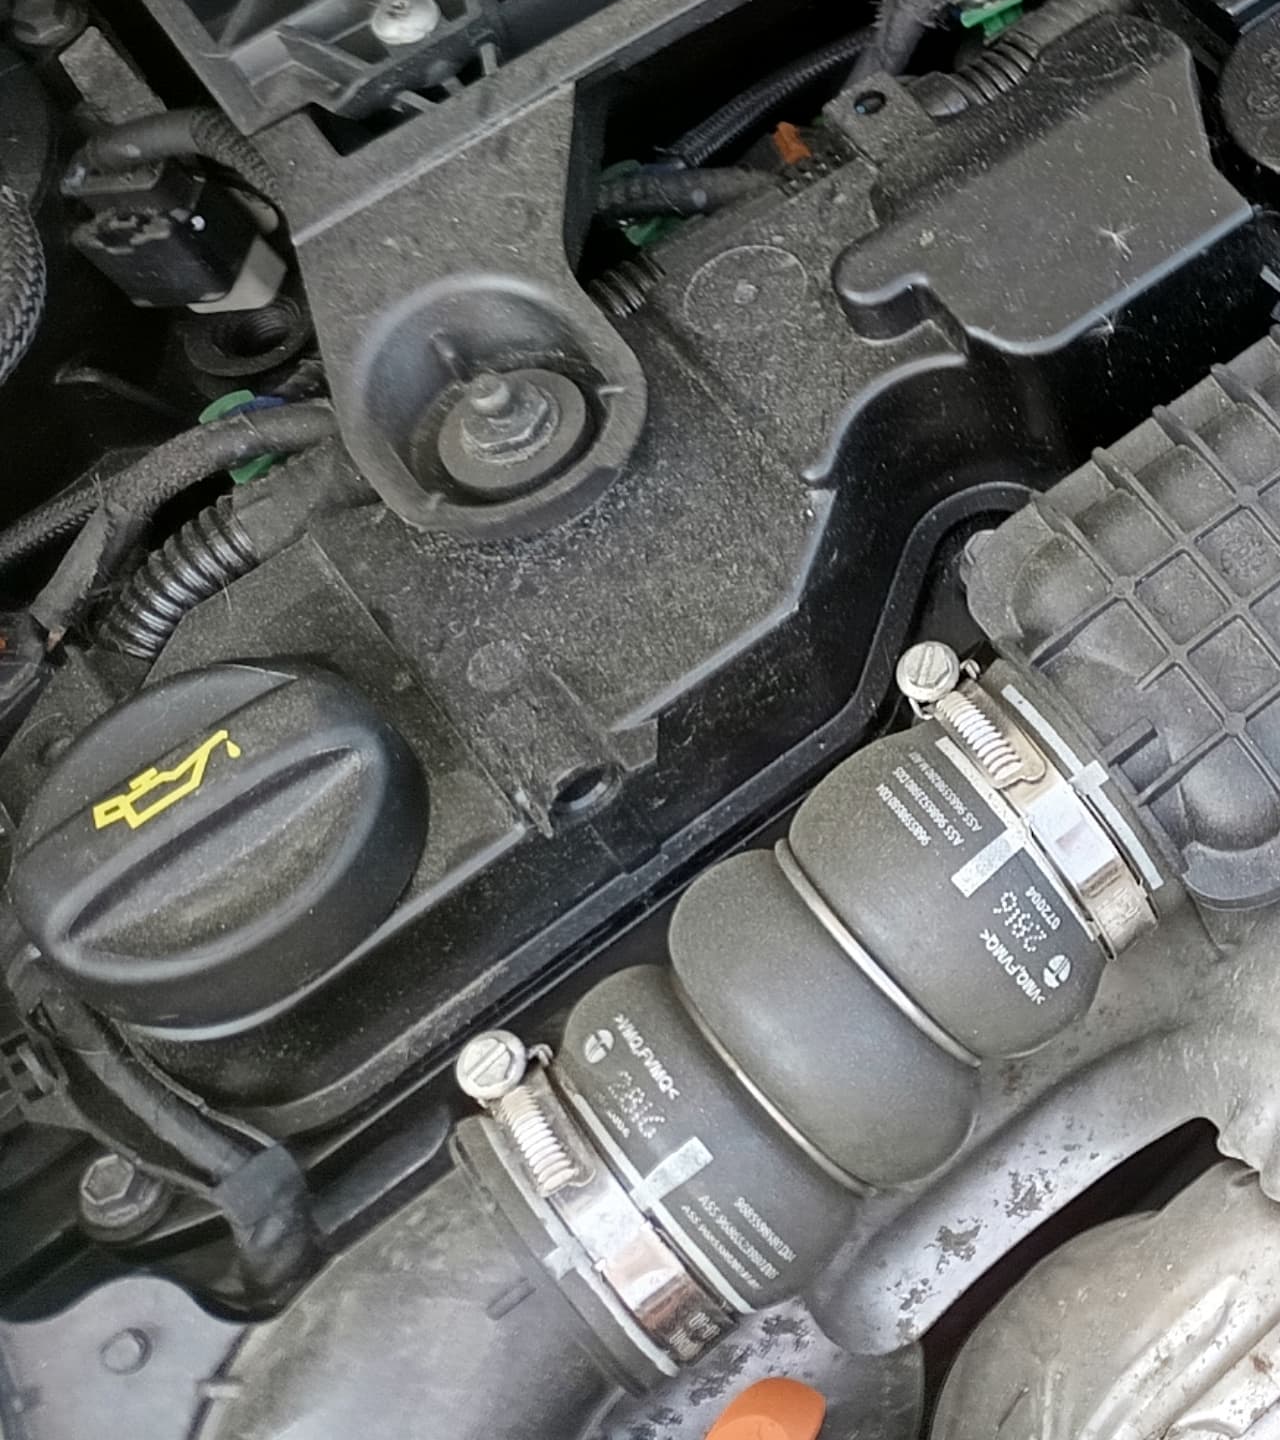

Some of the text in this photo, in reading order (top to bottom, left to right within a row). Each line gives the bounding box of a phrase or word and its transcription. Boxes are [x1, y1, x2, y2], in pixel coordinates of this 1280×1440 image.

[960, 810, 983, 834] ASS
[941, 823, 965, 848] ASS
[1022, 884, 1064, 930] 072004
